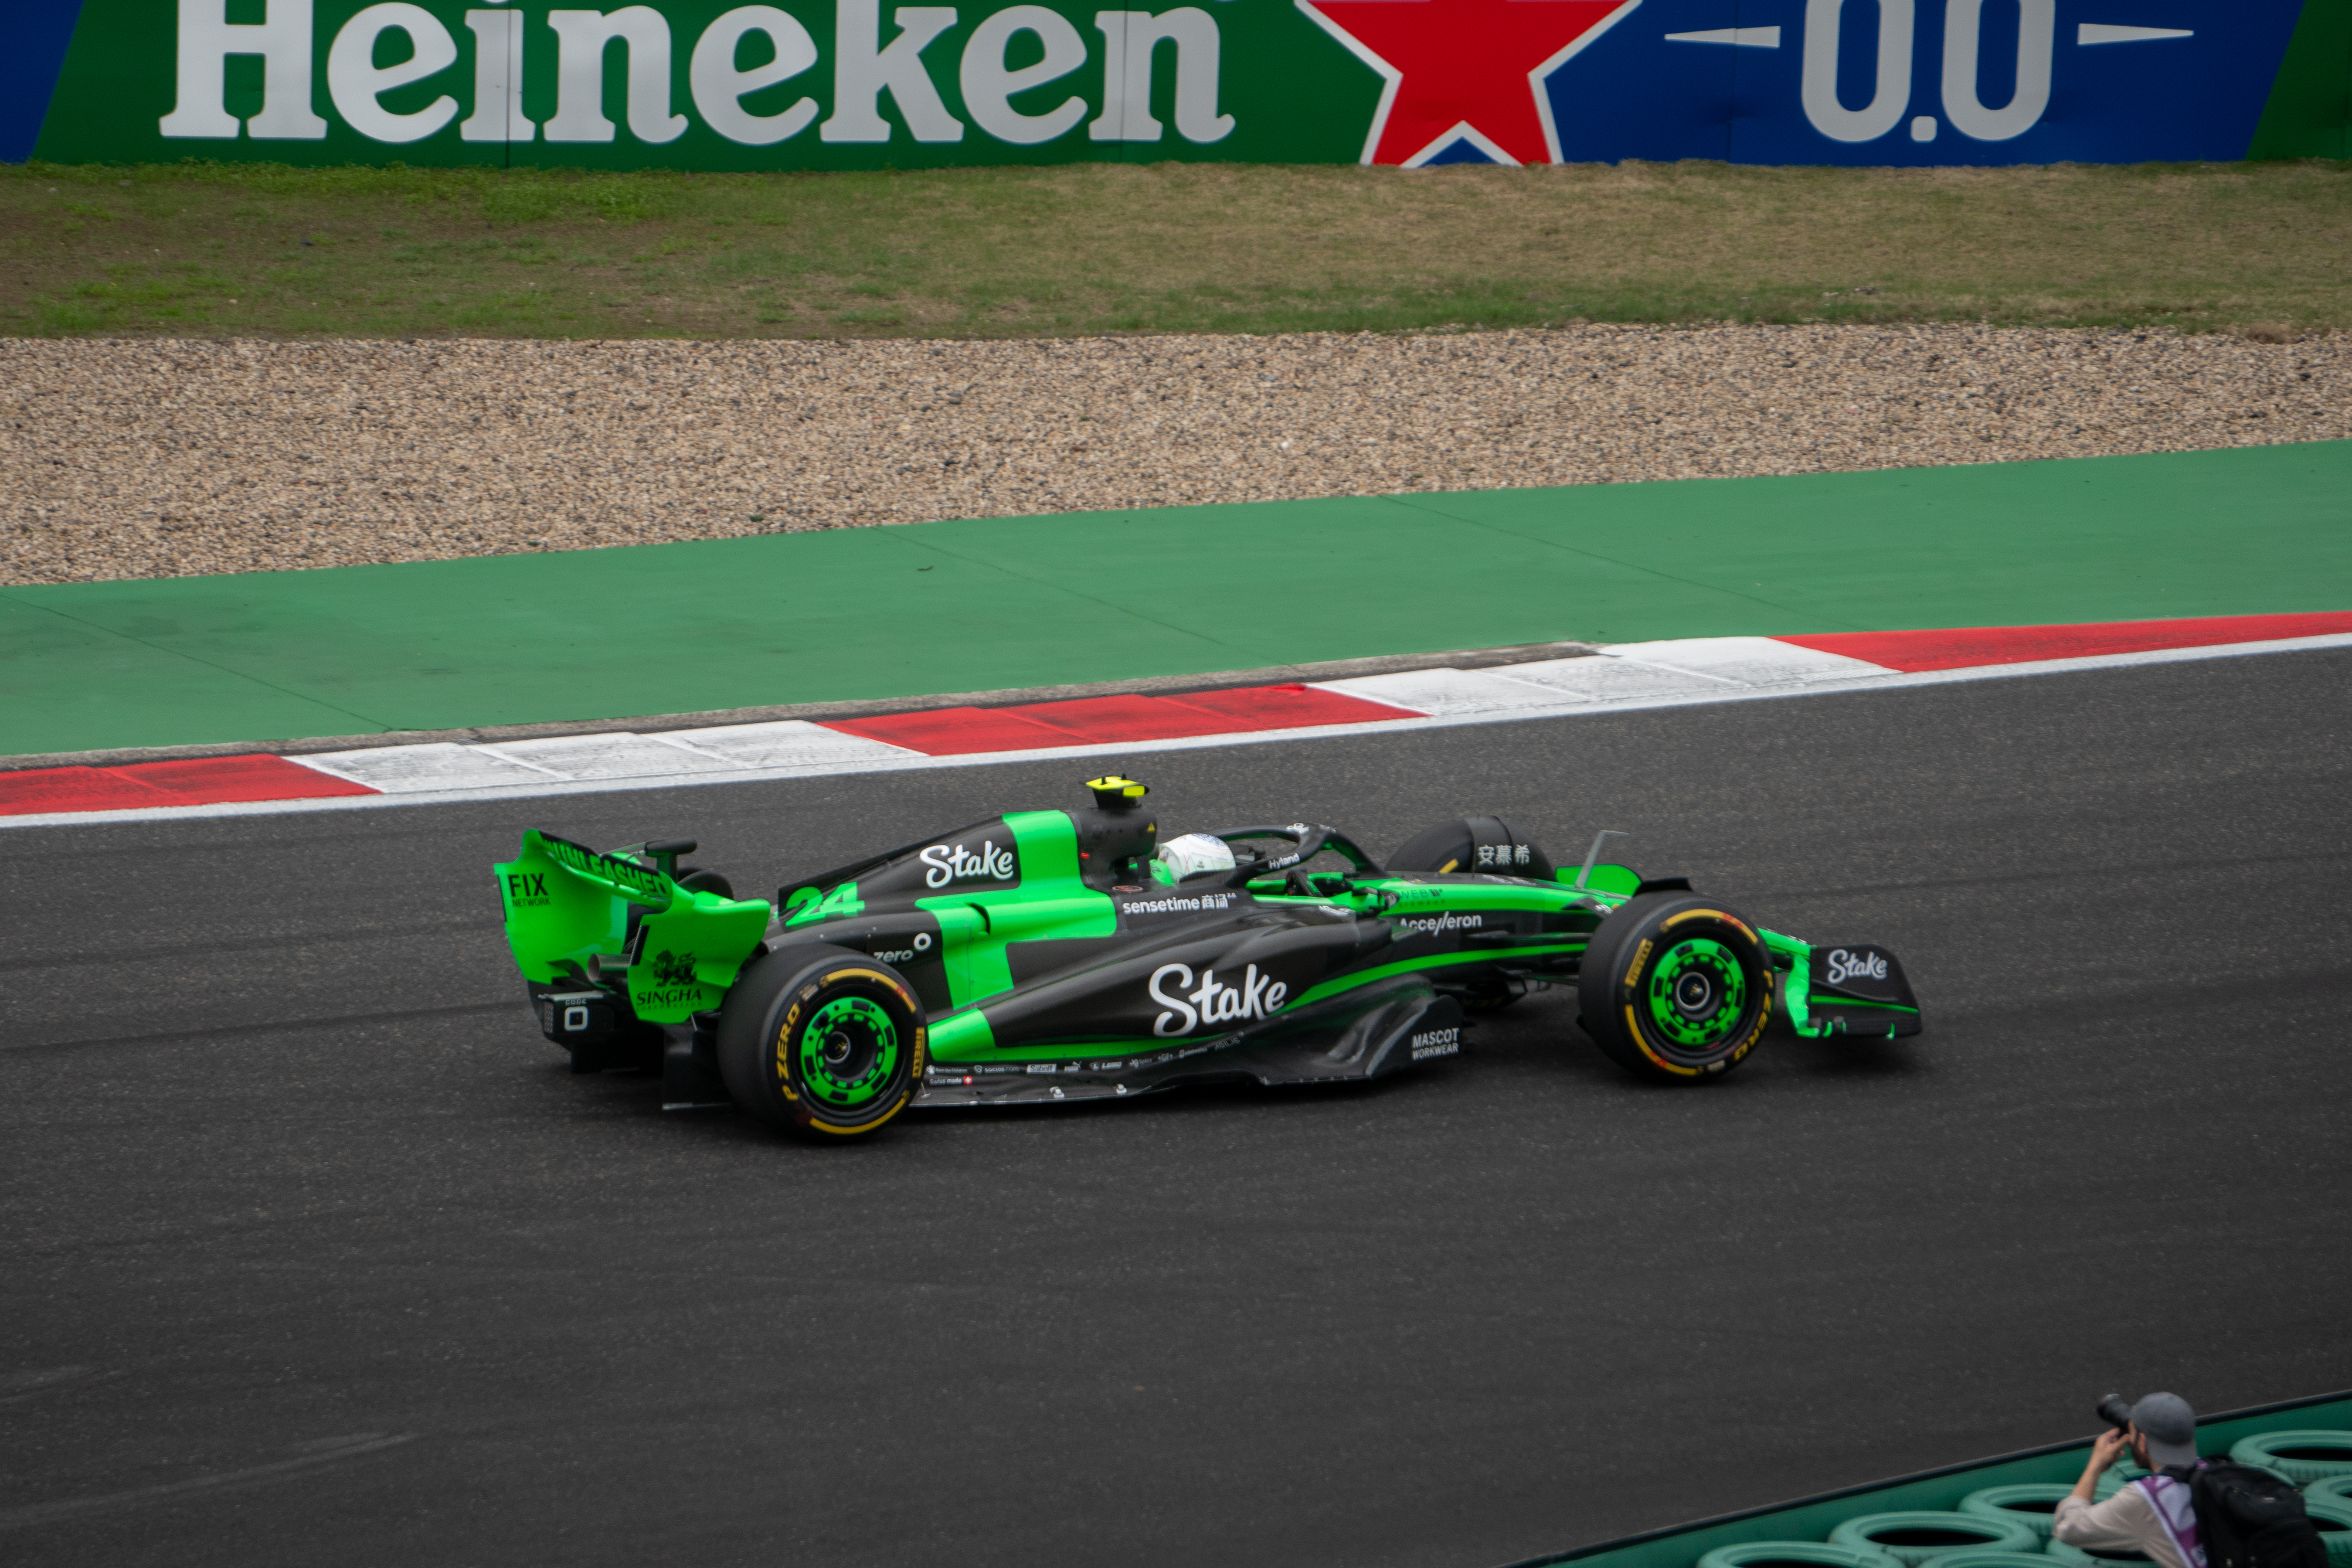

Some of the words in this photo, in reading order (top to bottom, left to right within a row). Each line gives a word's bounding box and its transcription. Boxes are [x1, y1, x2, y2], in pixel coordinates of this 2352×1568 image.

[160, 0, 1236, 145] Heineken
[1800, 0, 2056, 143] 0.0
[920, 840, 1014, 889] Stake
[1268, 853, 1300, 870] Hyland
[1478, 844, 1530, 866] 安慕希
[508, 872, 548, 897] FIX
[512, 897, 551, 907] NETWORK
[785, 882, 865, 927] 24
[1122, 896, 1200, 915] sensetime
[873, 949, 914, 963] zero
[1827, 949, 1888, 985] Stake
[636, 989, 702, 1005] SINGHA
[1149, 963, 1288, 1037] Stake
[776, 1002, 801, 1081] ZERO
[1412, 1027, 1460, 1049] MASCOT
[912, 1026, 925, 1078] PIRELLI
[1412, 1042, 1459, 1061] WORKWEAR
